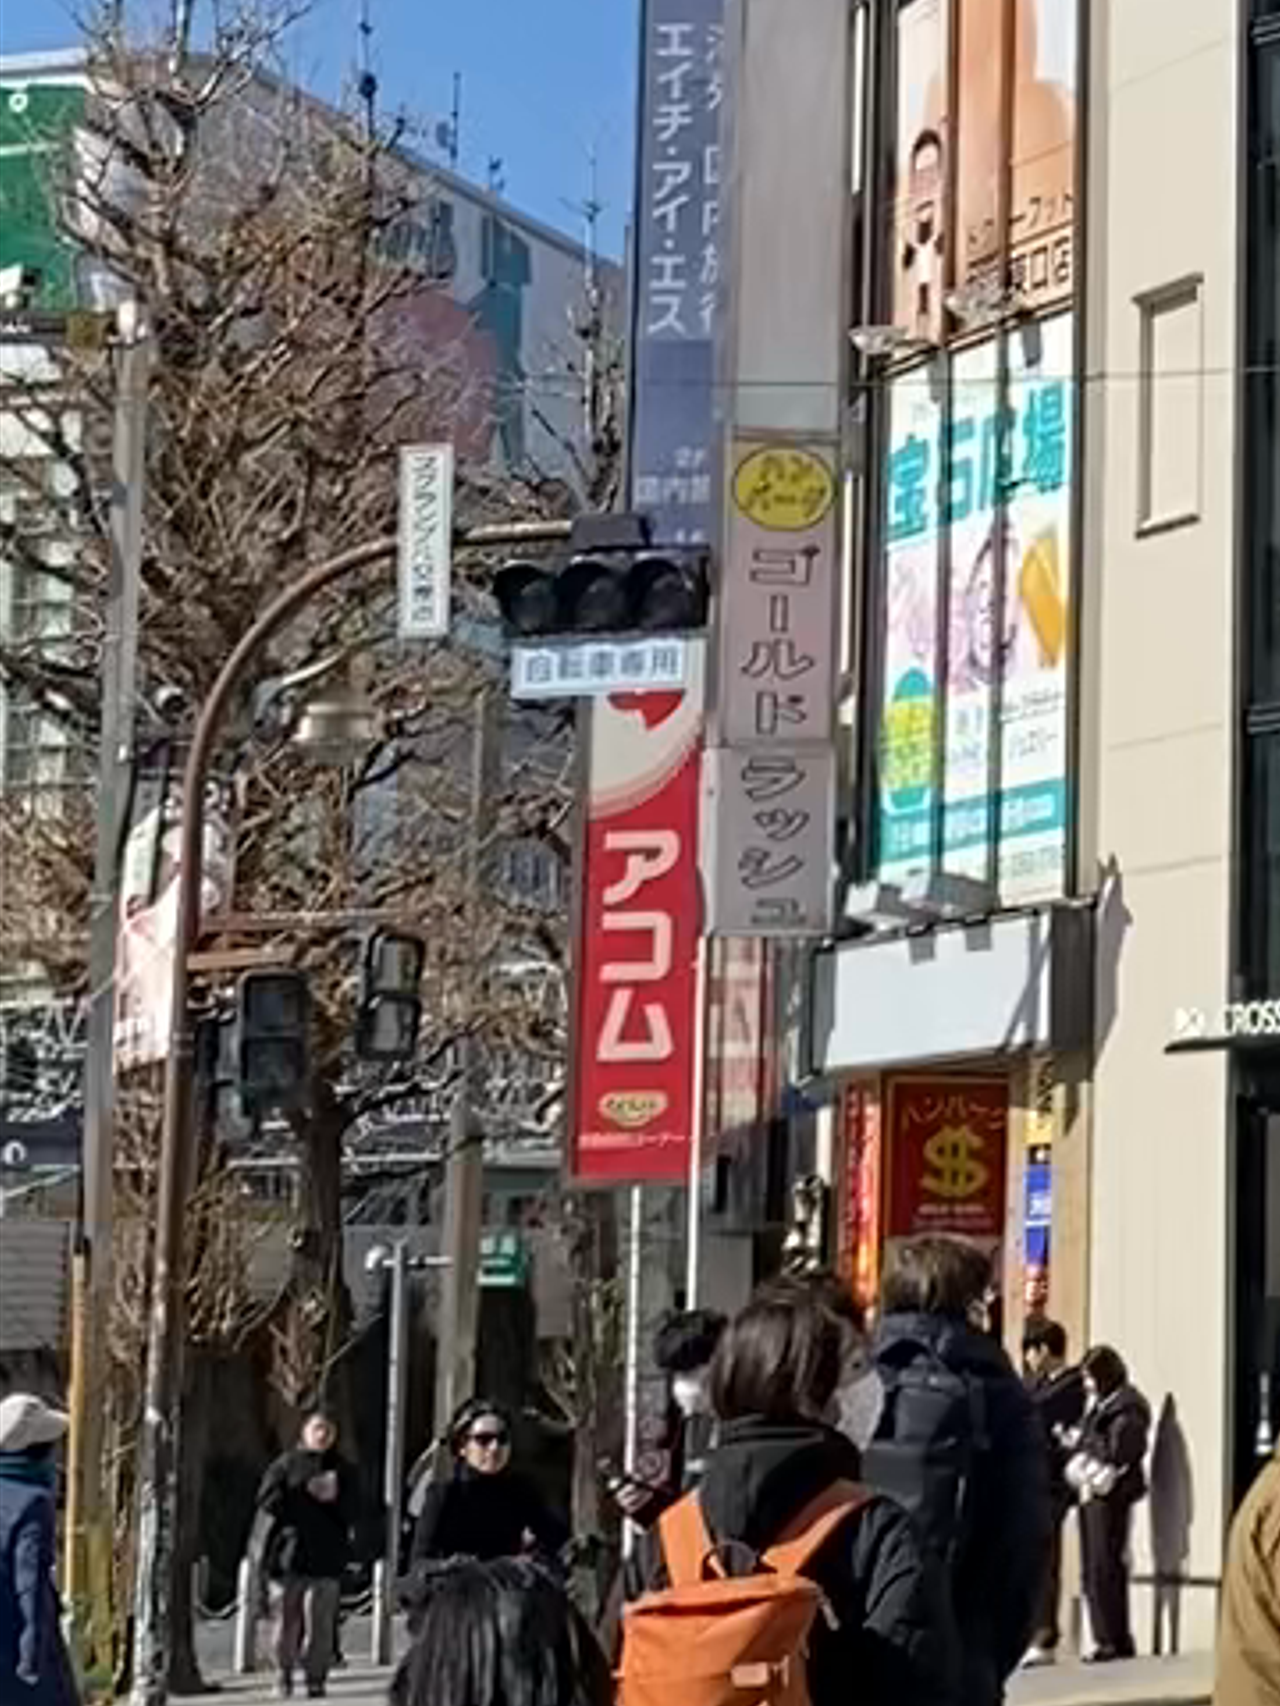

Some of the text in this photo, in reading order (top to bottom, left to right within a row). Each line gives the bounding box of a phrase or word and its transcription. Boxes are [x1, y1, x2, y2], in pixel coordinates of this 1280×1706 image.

[647, 22, 694, 336] エイチ・アイ・エス
[524, 646, 682, 686] 自転車専用
[740, 544, 820, 928] ゴールドラッシュ
[596, 829, 682, 1063] アコム
